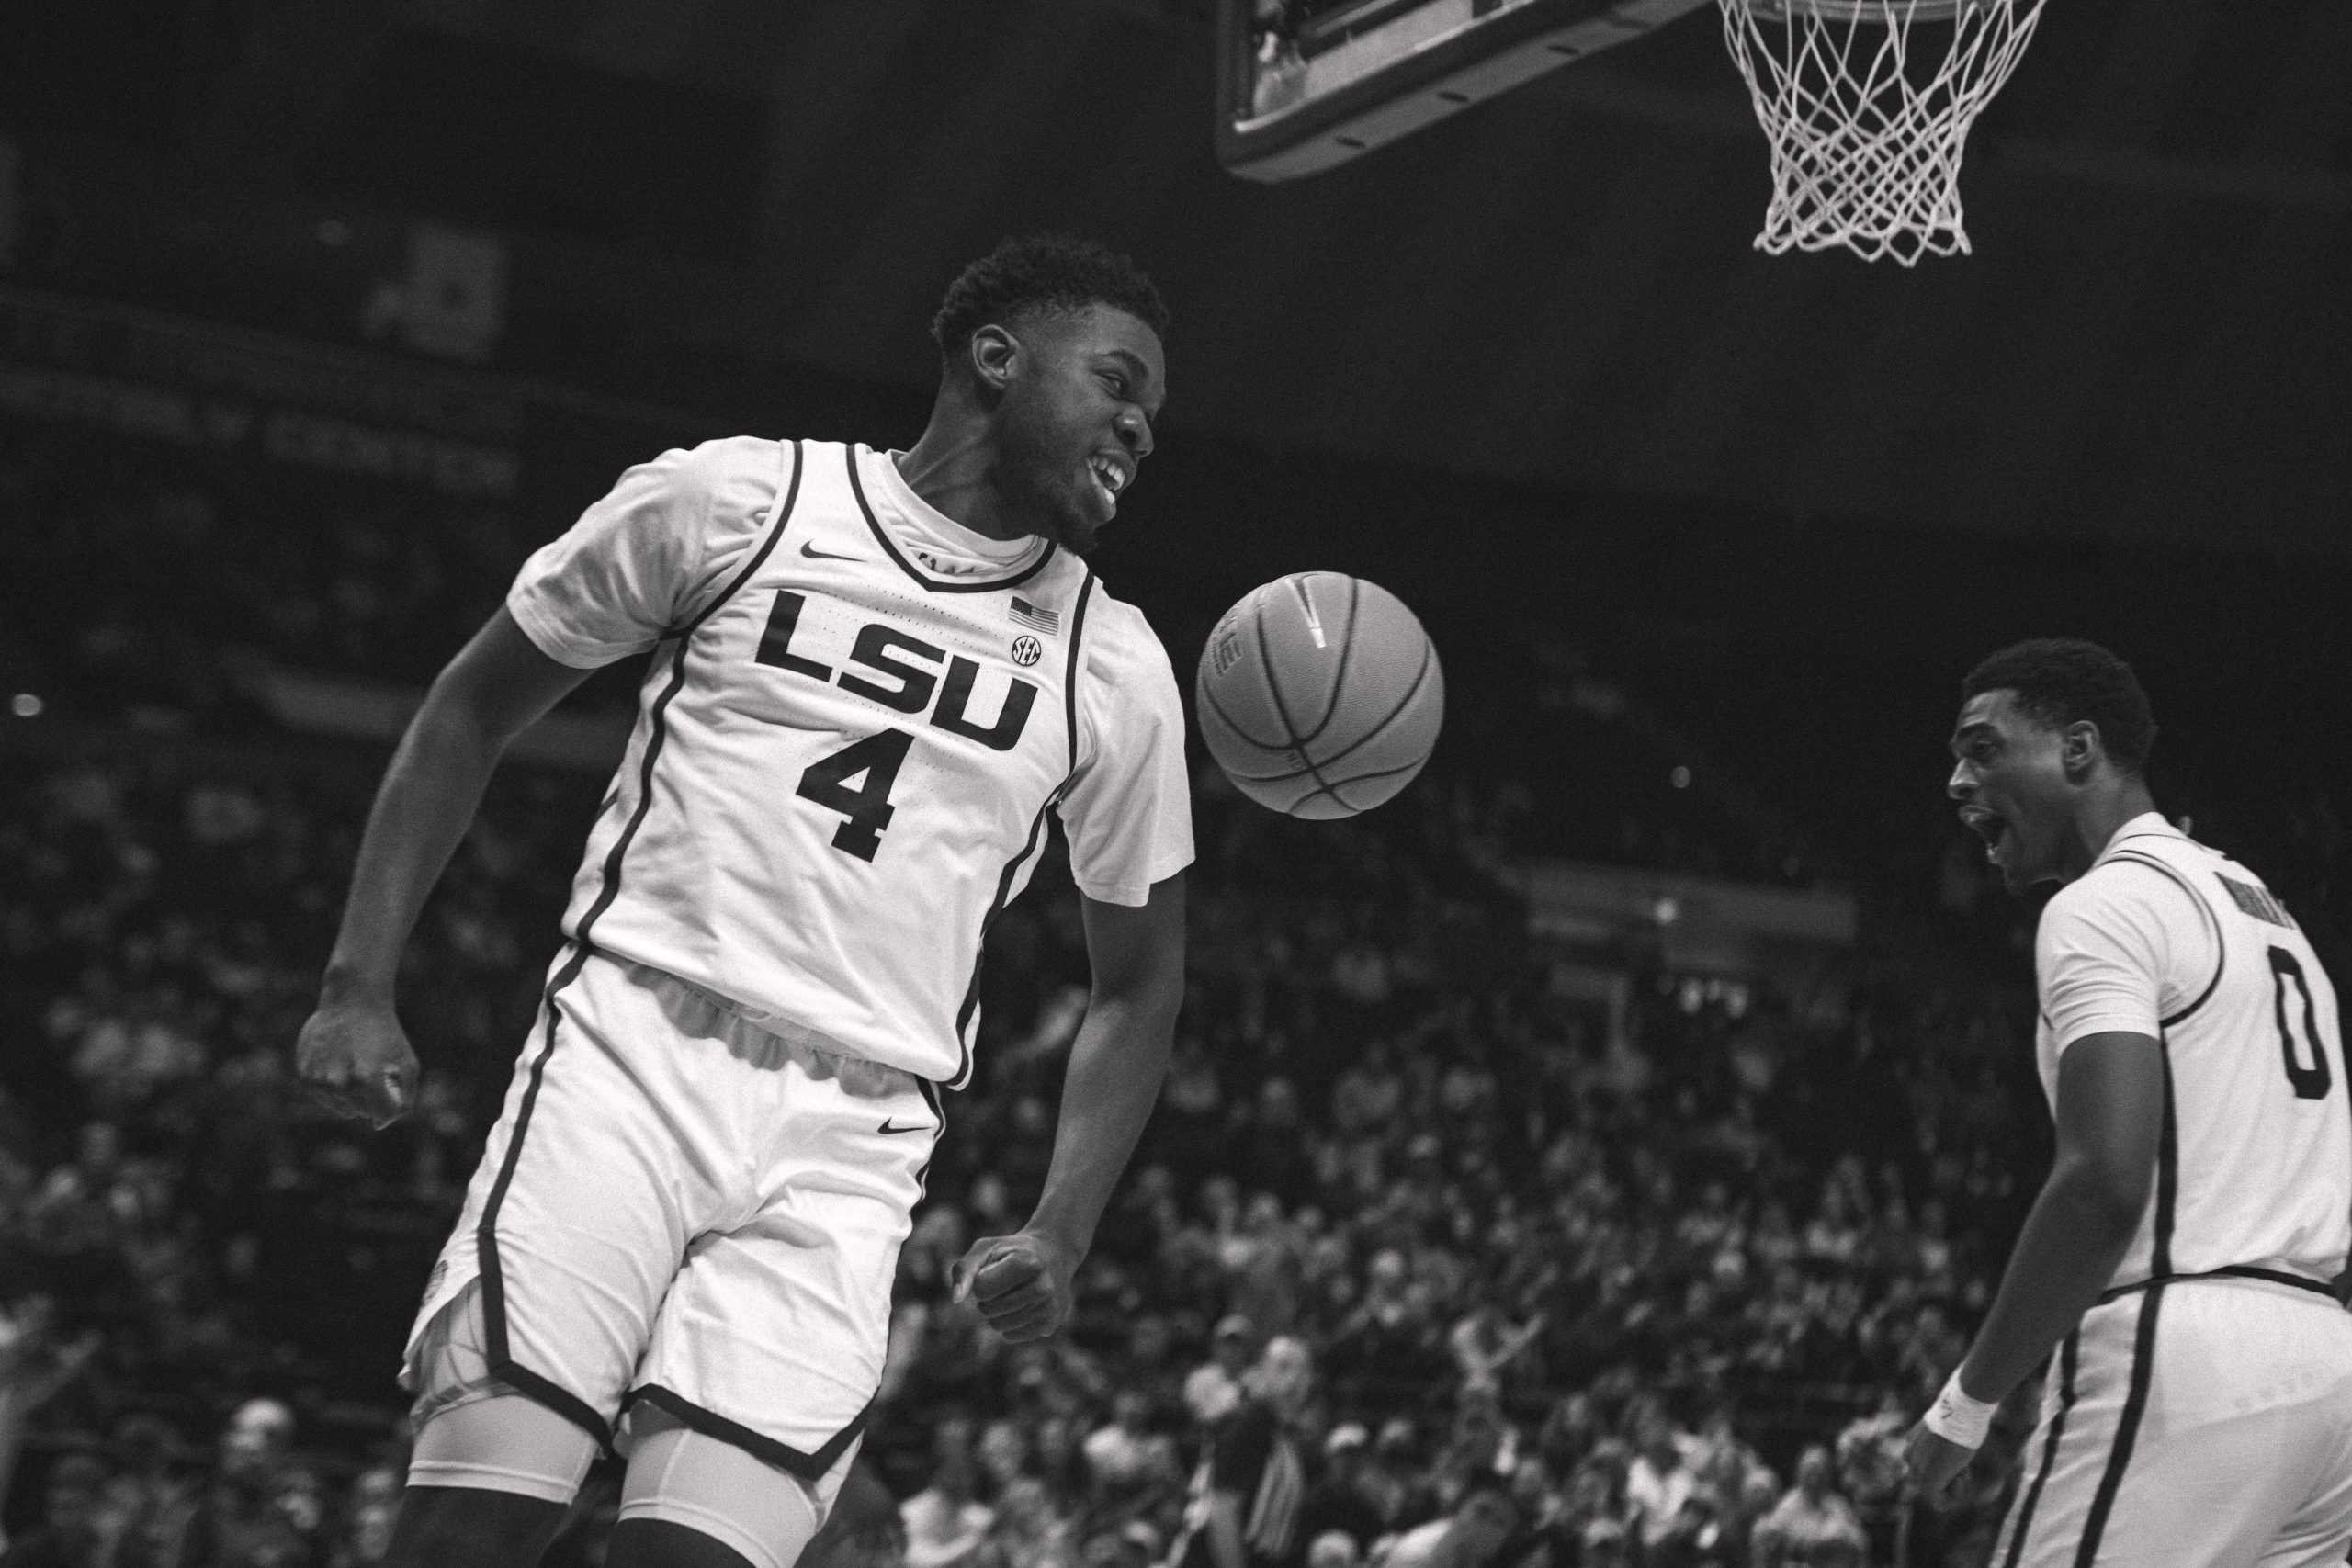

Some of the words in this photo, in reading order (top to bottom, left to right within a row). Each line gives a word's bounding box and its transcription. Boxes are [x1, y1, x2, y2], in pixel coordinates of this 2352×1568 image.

[755, 590, 1038, 751] LSU
[1012, 636, 1041, 665] SEC
[796, 728, 915, 863] 4
[2267, 944, 2333, 1100] 0
